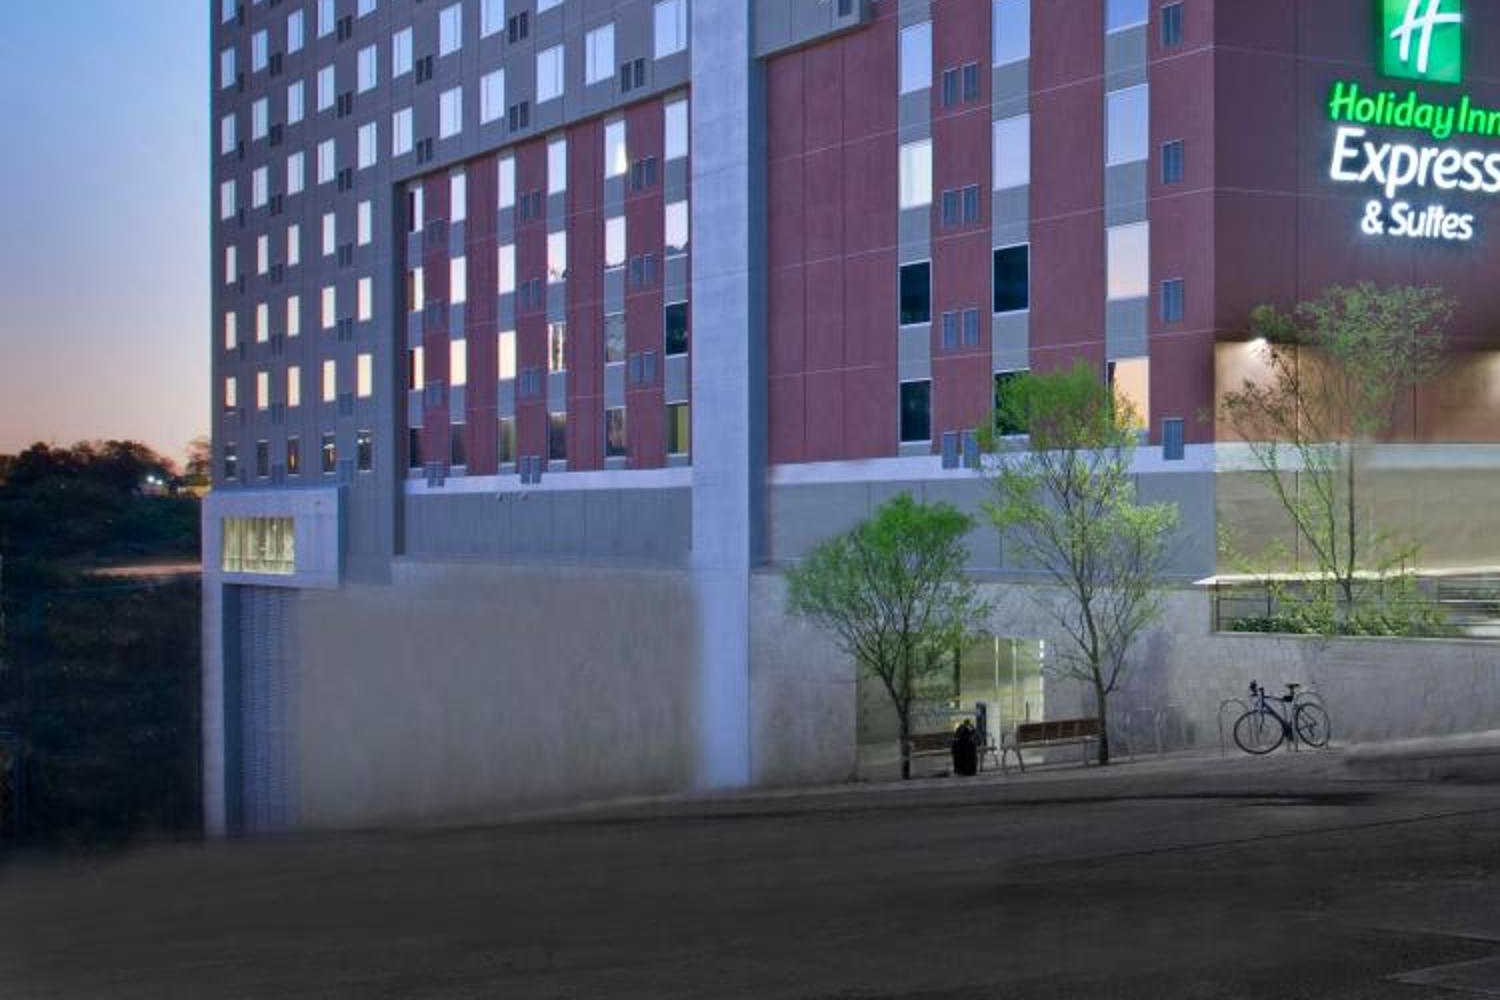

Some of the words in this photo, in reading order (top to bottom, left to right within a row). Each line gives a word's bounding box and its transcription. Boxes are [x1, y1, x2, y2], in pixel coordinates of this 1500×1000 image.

[1329, 82, 1454, 139] Holiday
[1361, 200, 1383, 235] &
[1388, 202, 1474, 240] Suites
